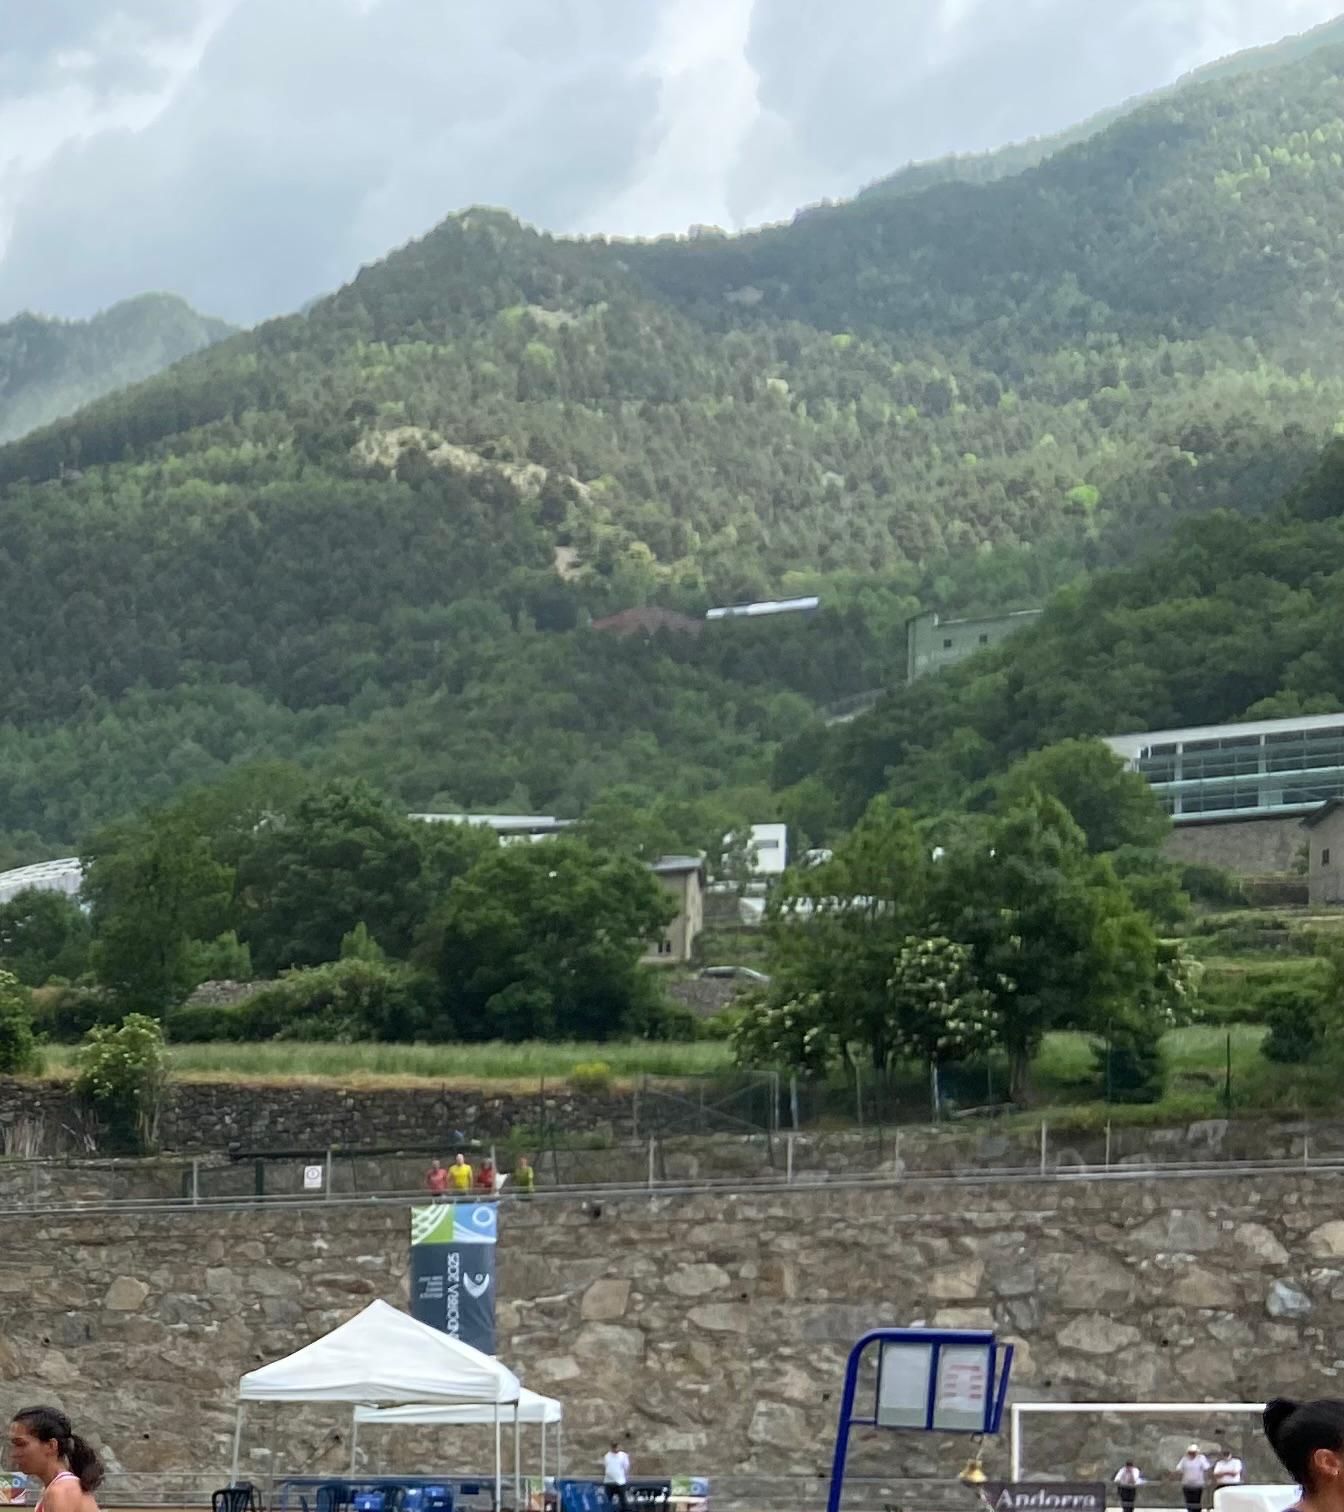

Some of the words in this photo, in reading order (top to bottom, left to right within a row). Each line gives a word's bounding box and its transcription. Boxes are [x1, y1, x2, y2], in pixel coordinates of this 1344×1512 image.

[447, 1252, 460, 1282] 2025
[446, 1283, 460, 1340] NDORRA
[995, 1488, 1096, 1508] Andorra
